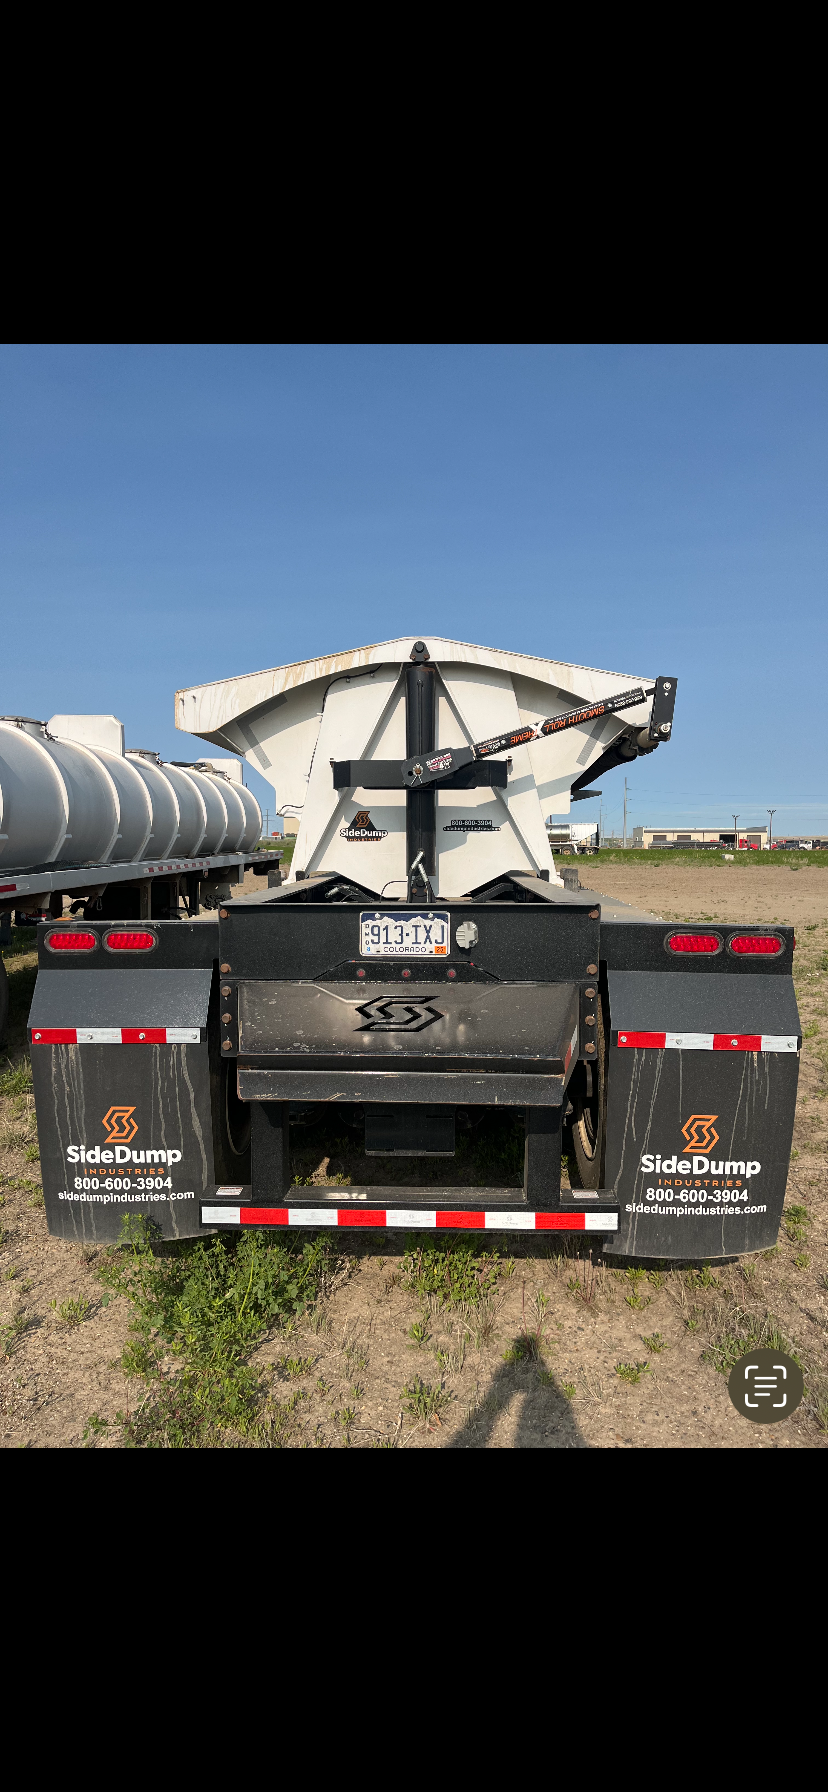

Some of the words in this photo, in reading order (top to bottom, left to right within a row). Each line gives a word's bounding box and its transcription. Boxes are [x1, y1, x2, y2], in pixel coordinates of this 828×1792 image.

[568, 705, 605, 725] SMOOTH
[543, 719, 567, 733] ROLL
[340, 828, 388, 838] SideDump
[66, 1145, 182, 1167] SideDump
[84, 1167, 165, 1175] INDUSTRIES
[640, 1154, 762, 1179] SideDump
[74, 1176, 172, 1190] 800-600-3904
[658, 1178, 743, 1187] INDUSTRIES
[58, 1191, 194, 1204] sidedumpindustries.com
[645, 1187, 749, 1203] 800-600-3904
[625, 1202, 767, 1217] sidedumpindustries.com
